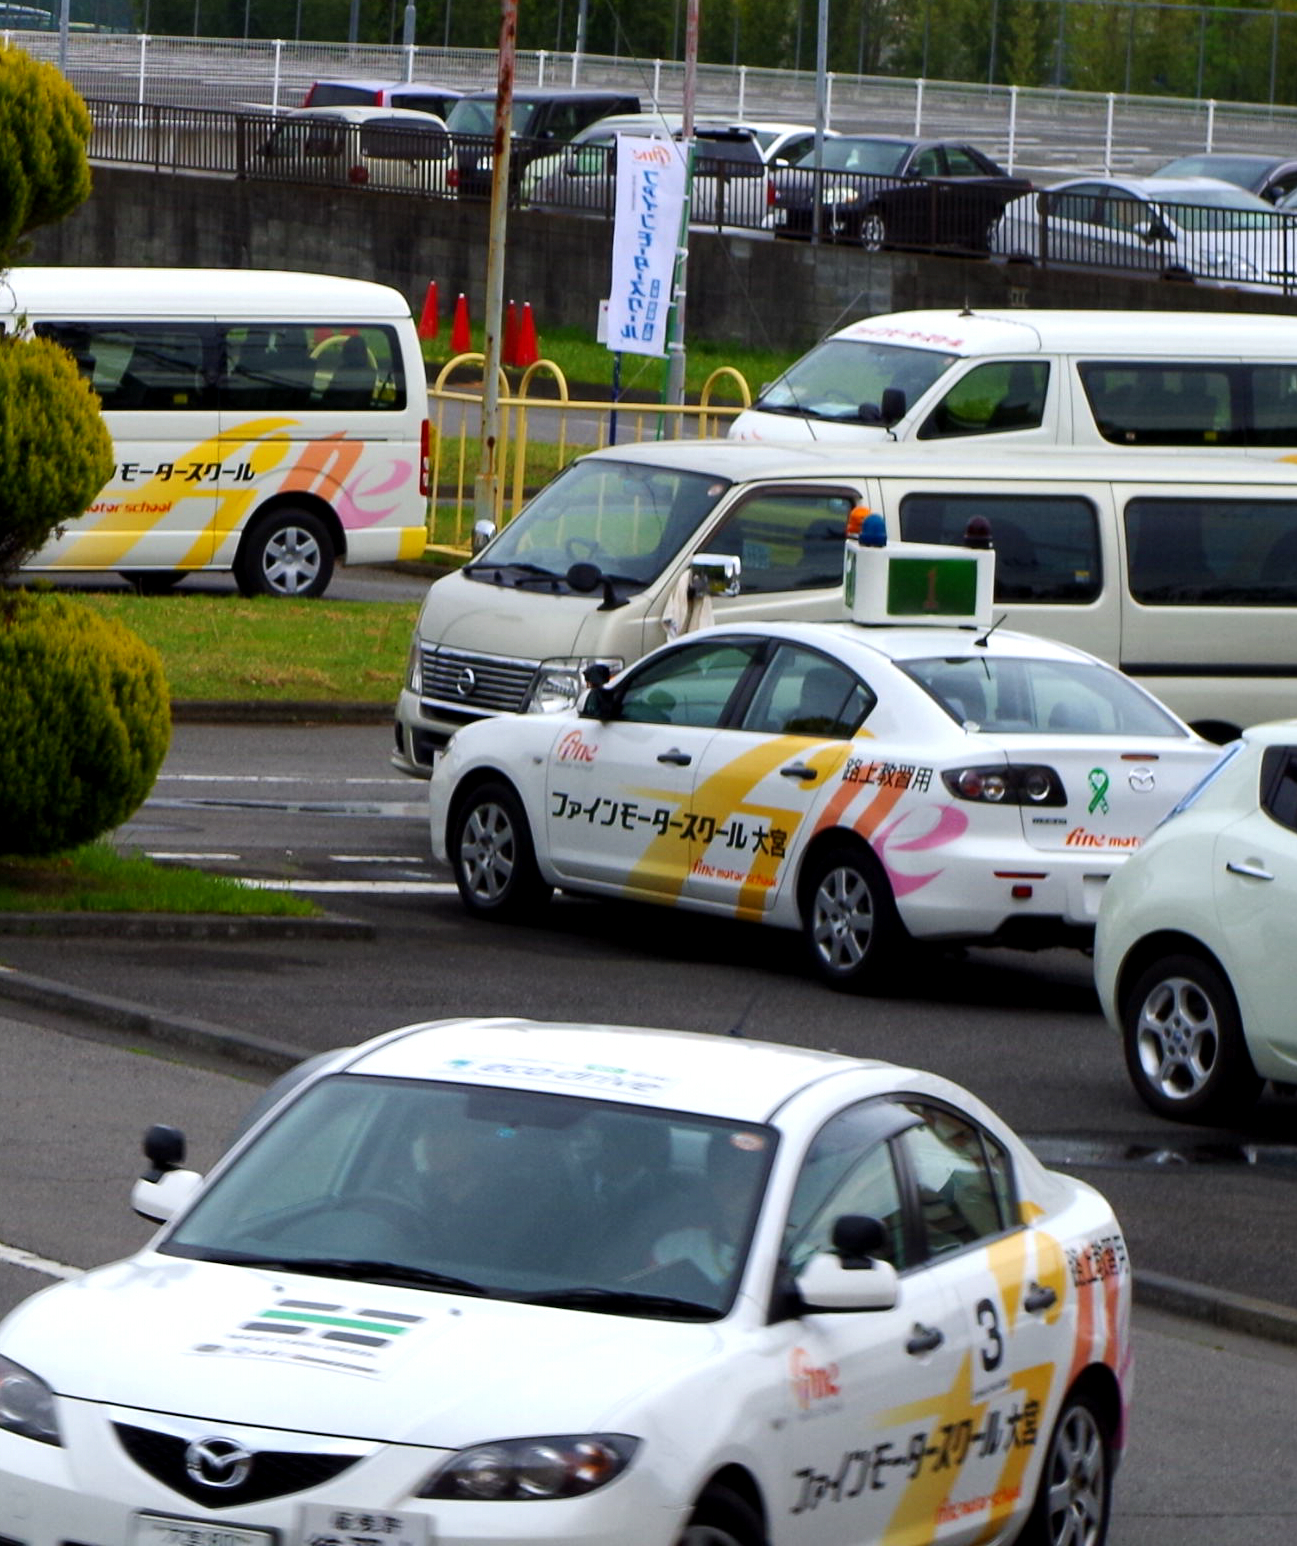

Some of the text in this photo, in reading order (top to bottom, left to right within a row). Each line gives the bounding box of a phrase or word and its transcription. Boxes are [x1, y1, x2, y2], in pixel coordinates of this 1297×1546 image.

[110, 462, 256, 482] モータースクール
[125, 501, 172, 513] school
[923, 566, 939, 609] 1
[557, 729, 599, 762] fine
[842, 758, 933, 793] 路上教習用
[552, 791, 788, 859] ファインモータースクール 大宮
[1065, 826, 1105, 847] fine
[692, 857, 716, 877] fine
[975, 1298, 1003, 1373] 3
[789, 1410, 1003, 1514] ファインモータースクール
